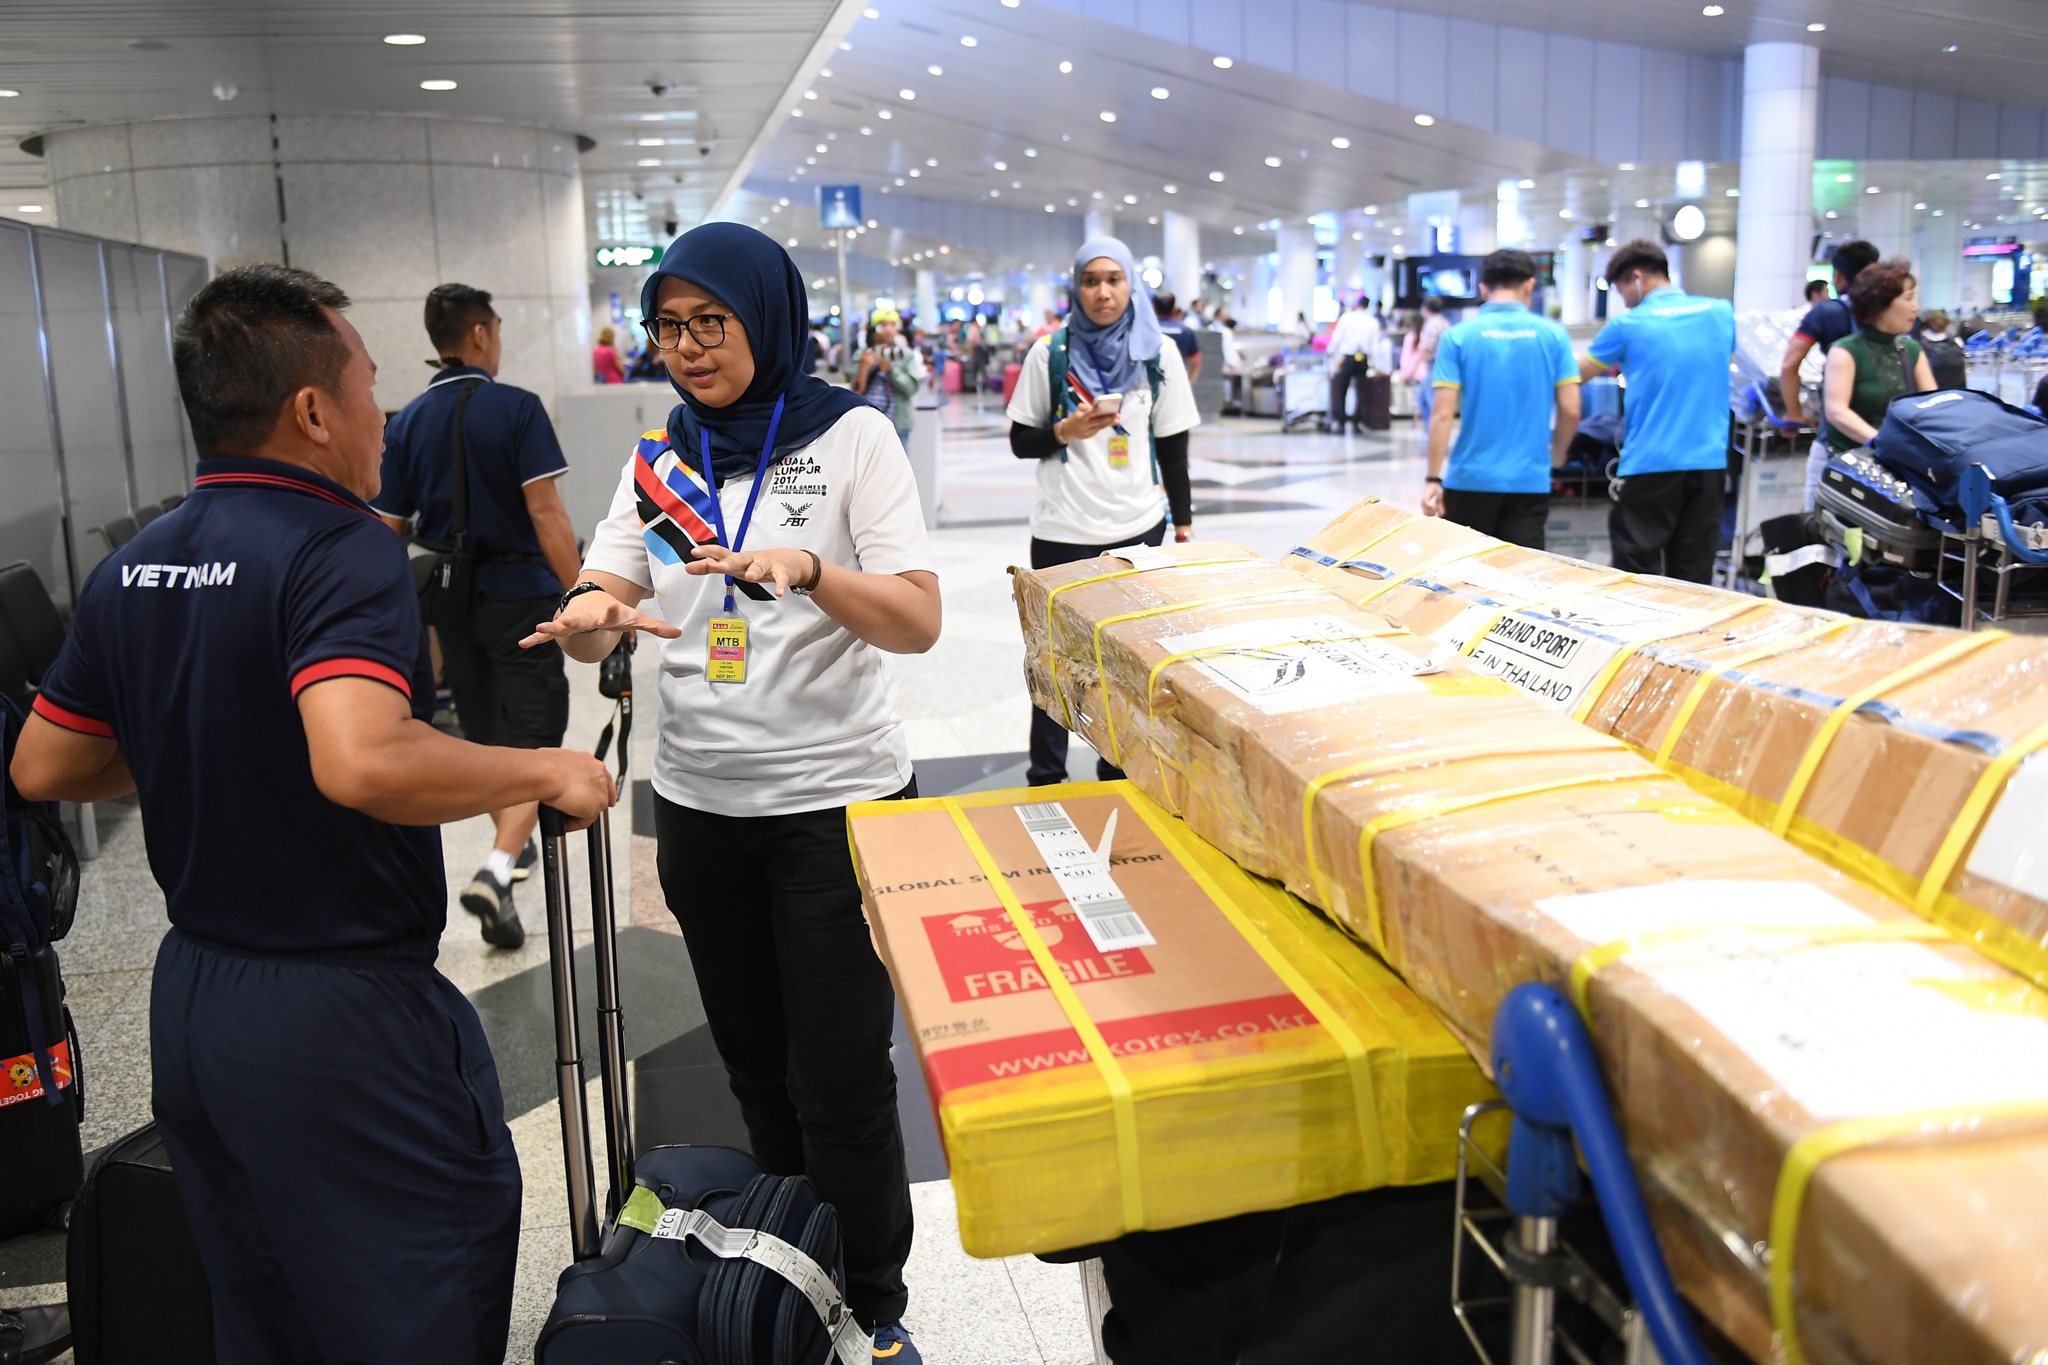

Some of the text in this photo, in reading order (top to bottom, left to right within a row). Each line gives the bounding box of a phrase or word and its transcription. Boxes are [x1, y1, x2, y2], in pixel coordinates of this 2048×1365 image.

[774, 465, 821, 476] LUMPUR
[776, 457, 814, 466] KUALA
[773, 476, 798, 485] 2017
[780, 517, 809, 527] FBT
[122, 562, 237, 589] VIETNAM
[716, 637, 740, 647] MTB
[1489, 616, 1578, 659] GRAND SPORT
[1483, 654, 1502, 669] IN
[1501, 661, 1572, 701] THAILAND
[871, 878, 962, 897] GLOBAL
[969, 870, 1021, 883] SM
[952, 923, 1002, 937] THIS
[964, 953, 1133, 998] FRAGILE
[988, 1013, 1306, 1077] wwwkorex.co.kr
[657, 1211, 677, 1237] EYCL
